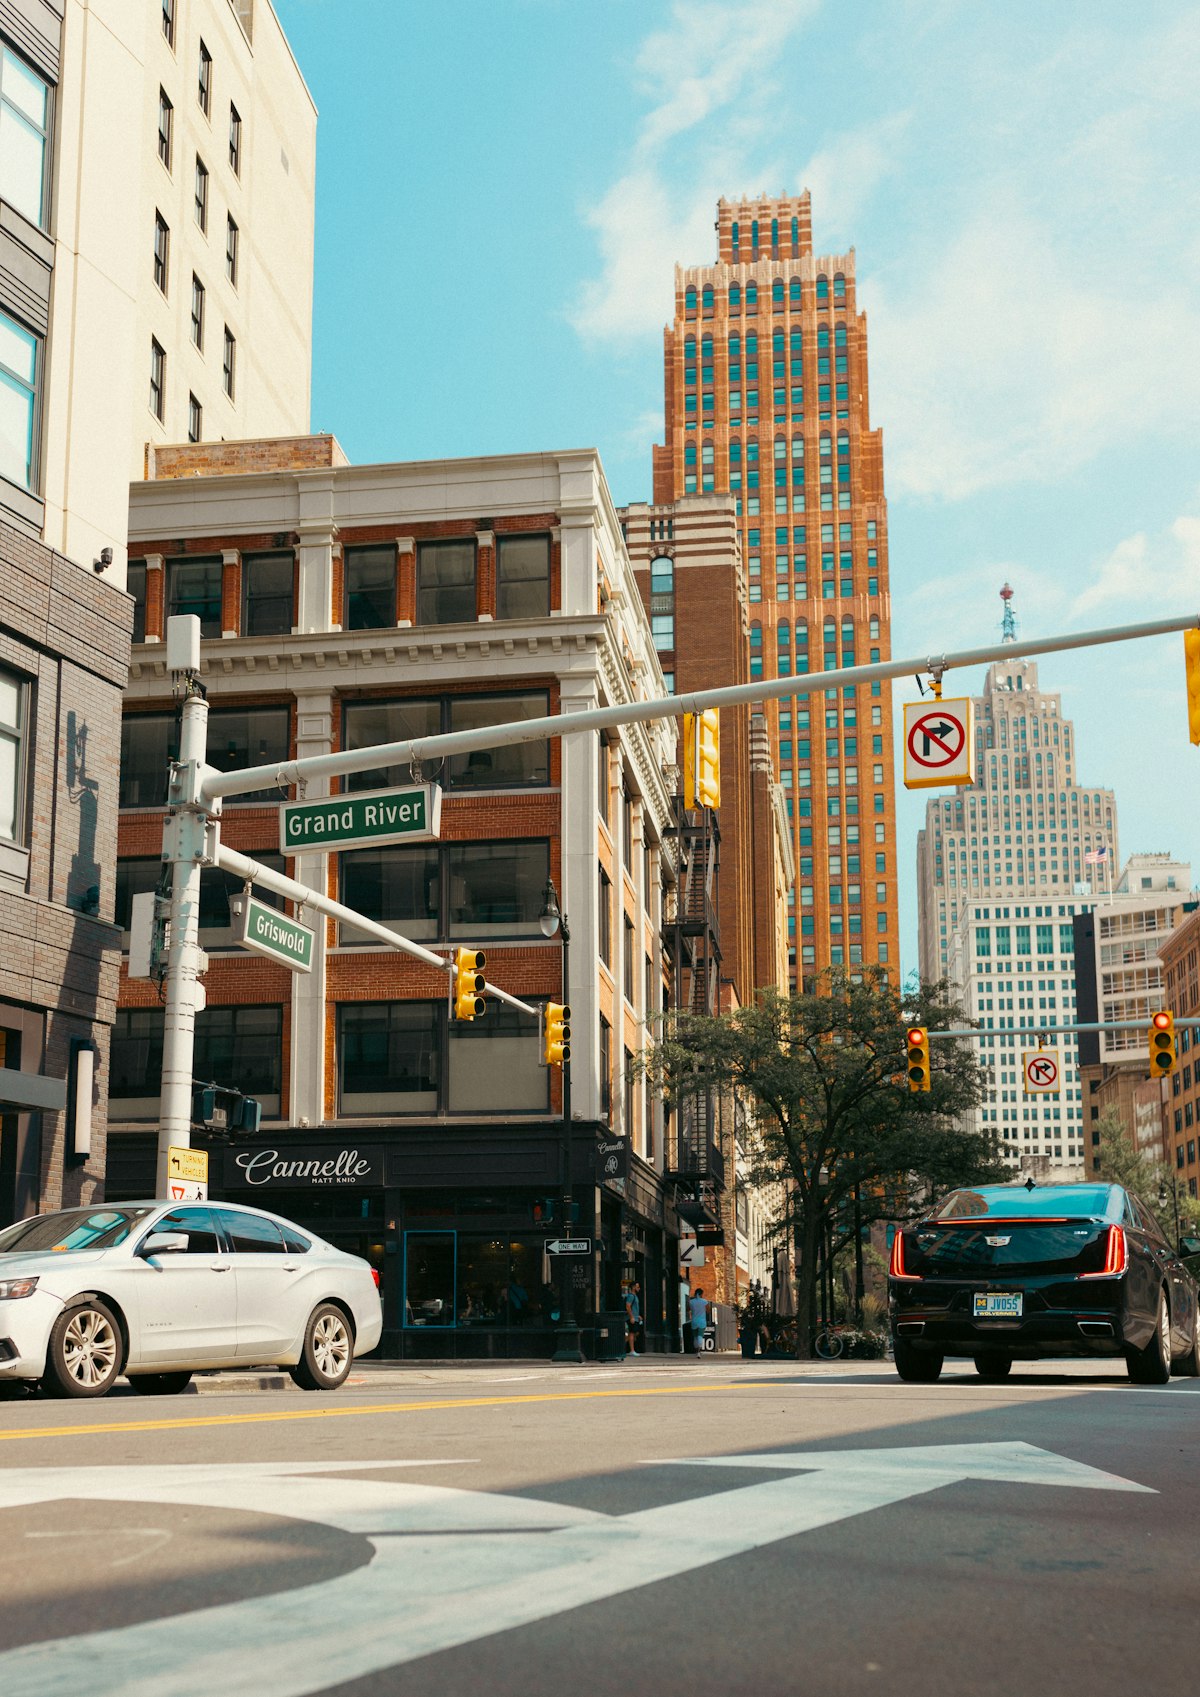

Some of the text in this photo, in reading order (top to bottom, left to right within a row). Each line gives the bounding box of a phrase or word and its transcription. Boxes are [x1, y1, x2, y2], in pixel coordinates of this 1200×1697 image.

[289, 802, 422, 836] Grand River
[256, 914, 306, 955] Griswold
[597, 1140, 625, 1155] Cannelle
[182, 1154, 205, 1166] TURNING
[235, 1149, 371, 1185] Cannelle
[182, 1167, 206, 1178] VEHICLES
